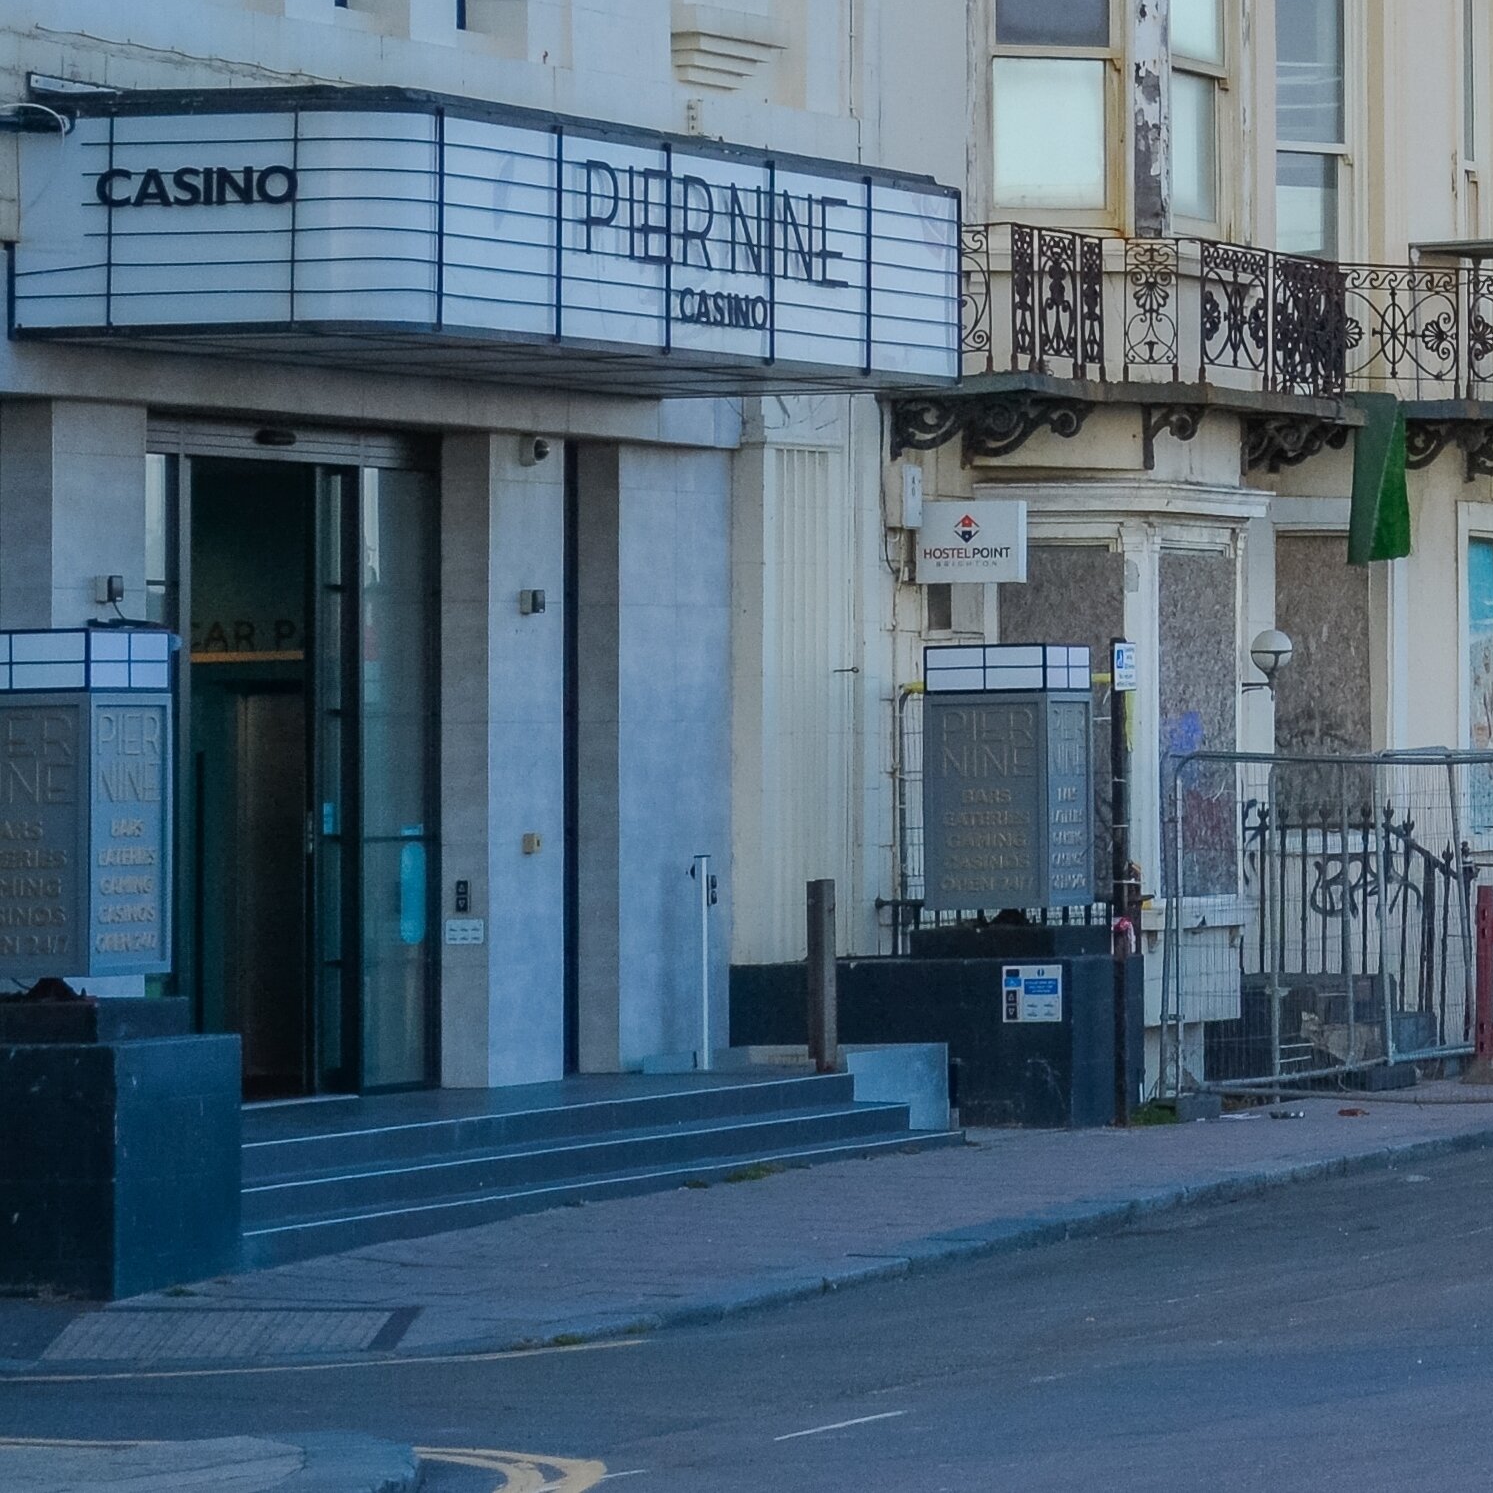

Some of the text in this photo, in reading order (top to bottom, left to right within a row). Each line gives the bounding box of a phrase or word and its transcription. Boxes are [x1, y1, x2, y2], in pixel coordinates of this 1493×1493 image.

[96, 164, 299, 208] CASINO
[586, 159, 714, 270] PIER
[679, 286, 769, 330] CASINO
[97, 714, 162, 757] PIER
[943, 708, 1035, 742] PIER
[97, 760, 162, 803] NINE
[943, 744, 1035, 778] NINE
